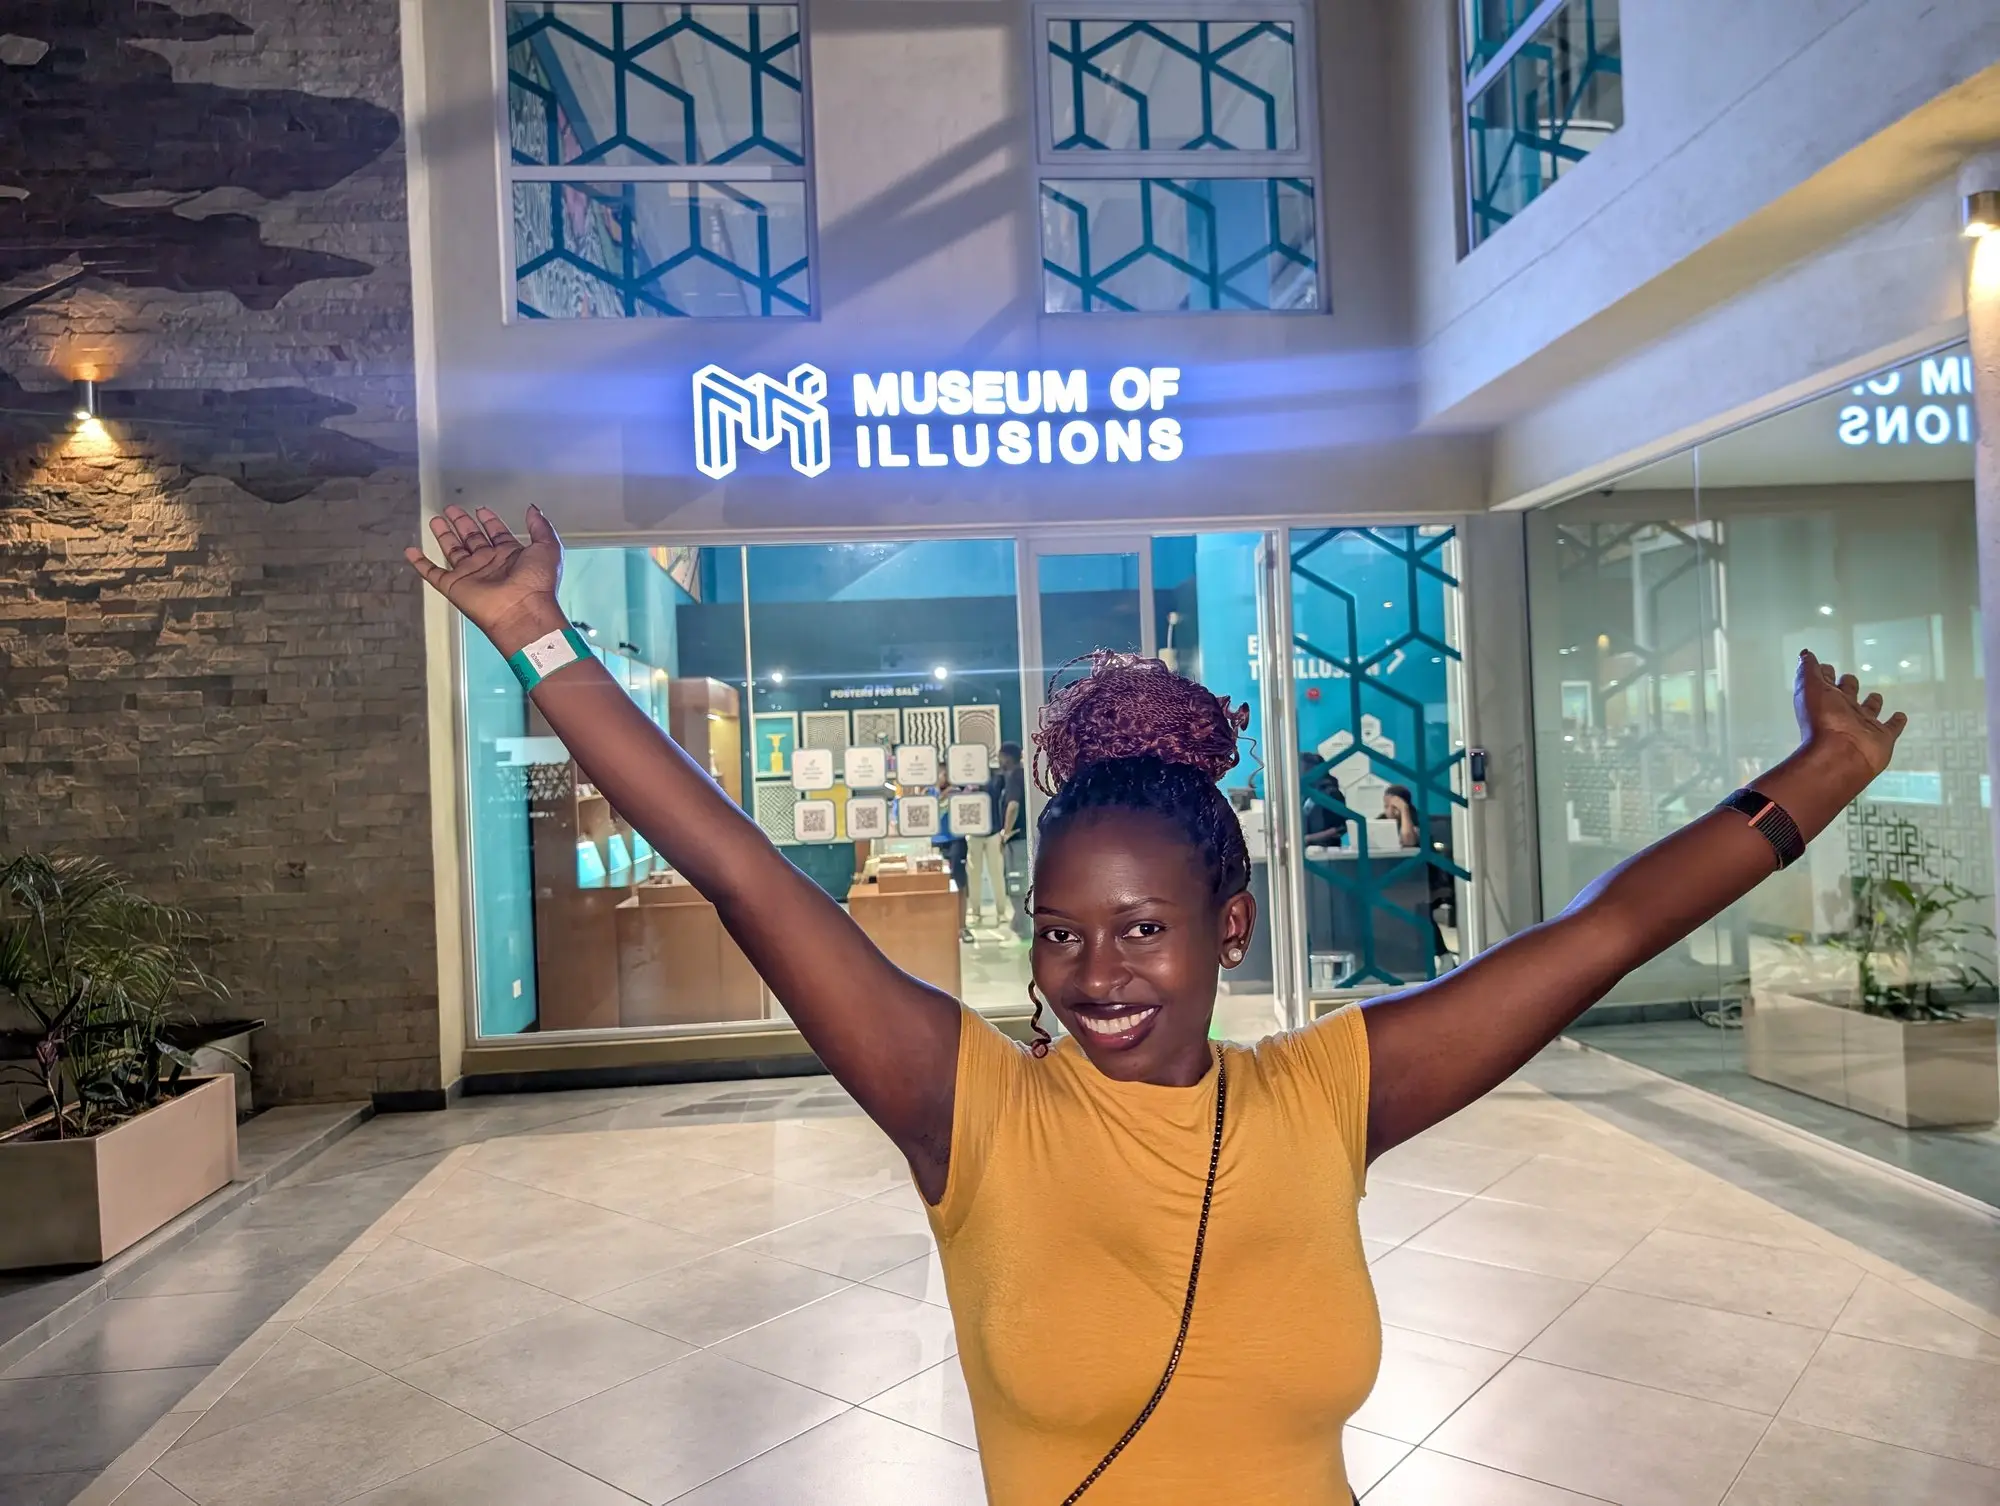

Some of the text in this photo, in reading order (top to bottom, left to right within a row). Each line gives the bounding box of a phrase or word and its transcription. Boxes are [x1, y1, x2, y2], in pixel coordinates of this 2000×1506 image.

[852, 366, 1181, 417] MUSEUM OF
[856, 417, 1184, 469] ILLUSIONS
[830, 688, 874, 699] POSTERS
[874, 687, 895, 697] FOR
[895, 686, 920, 697] SALE
